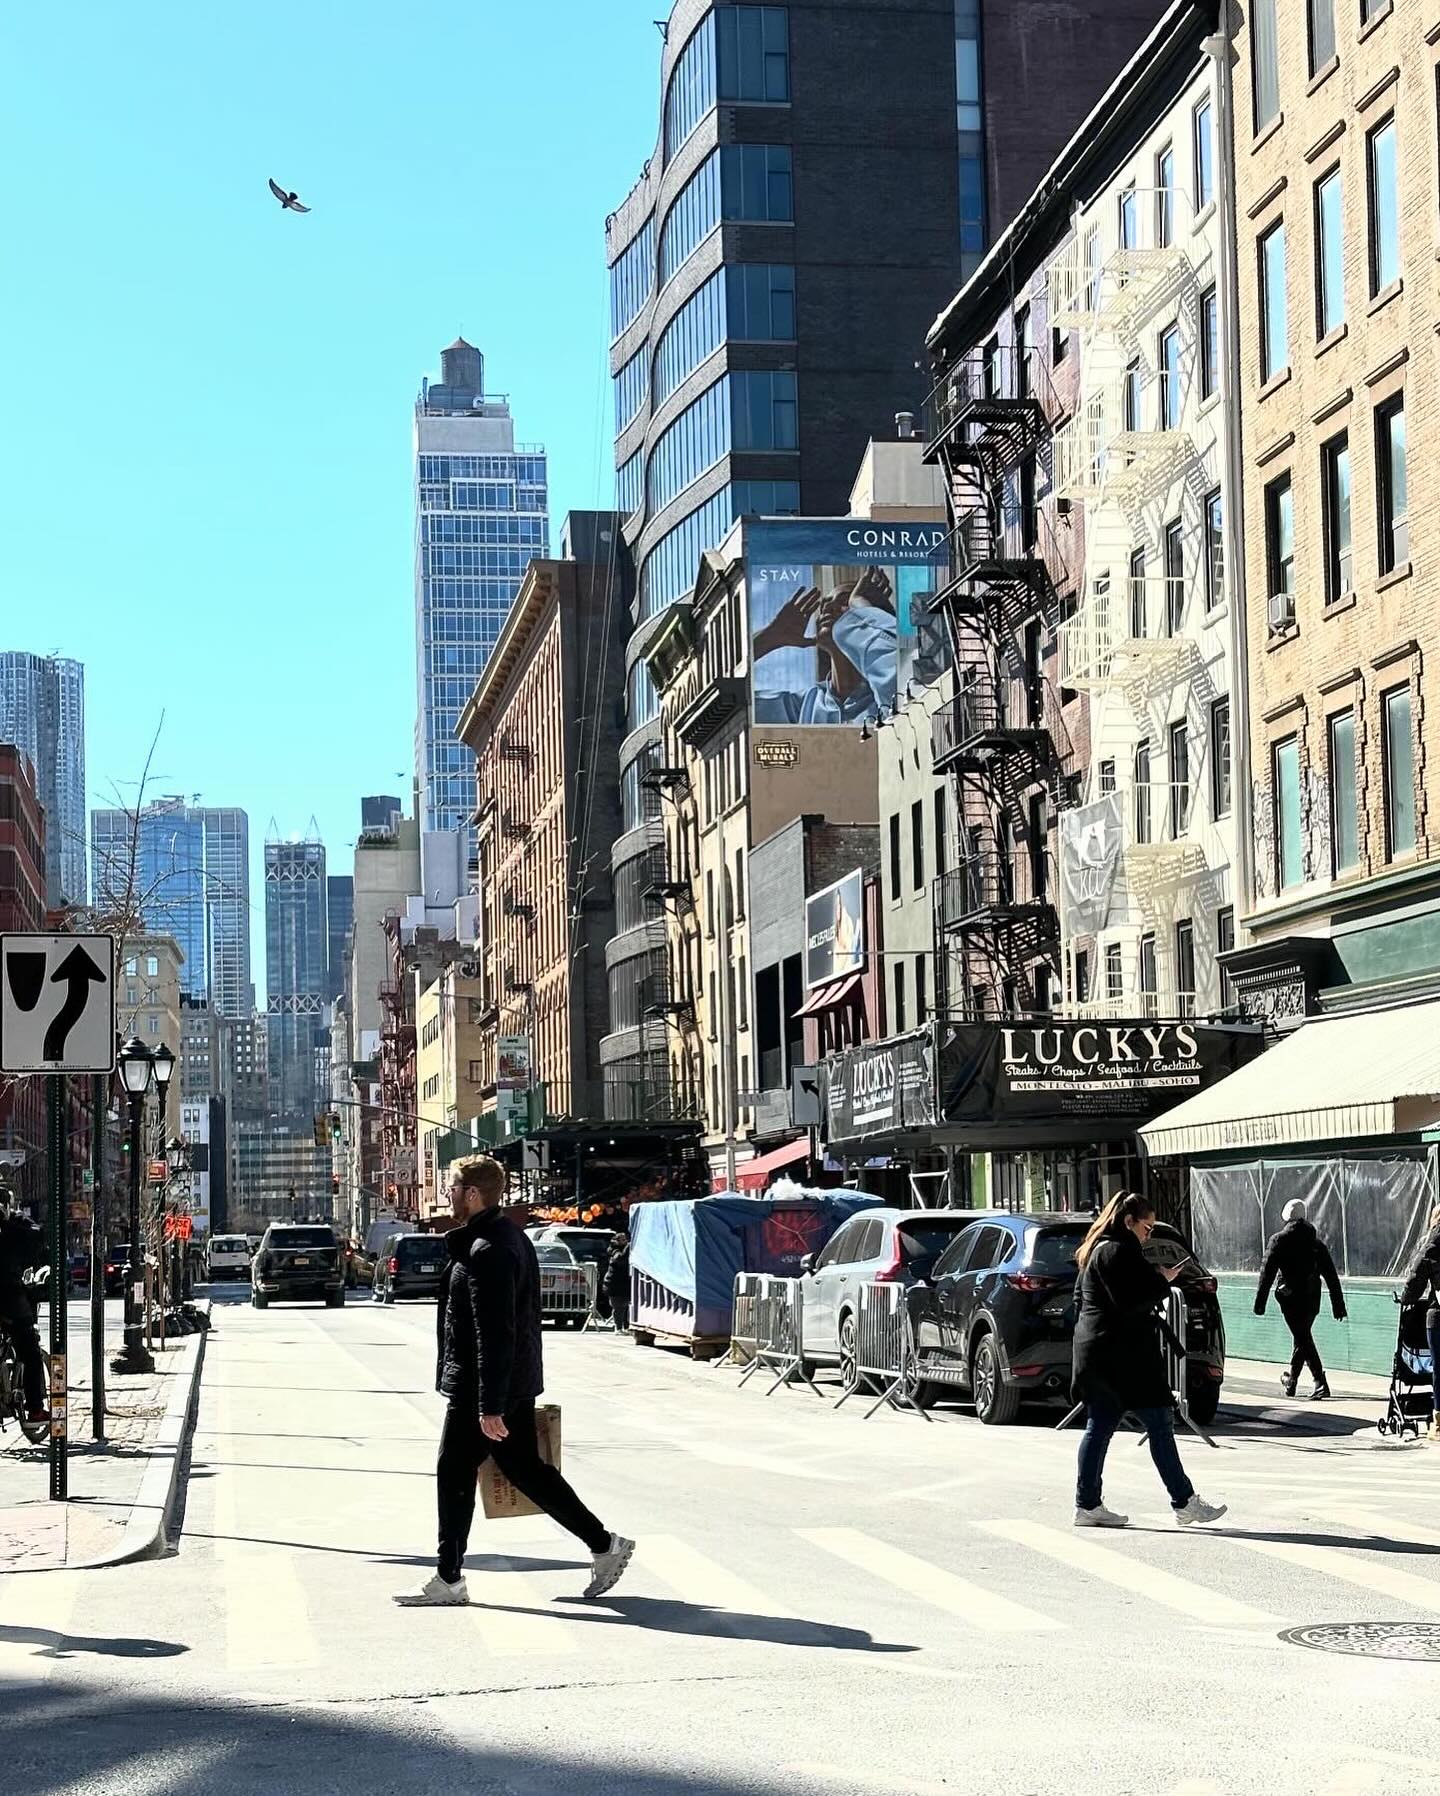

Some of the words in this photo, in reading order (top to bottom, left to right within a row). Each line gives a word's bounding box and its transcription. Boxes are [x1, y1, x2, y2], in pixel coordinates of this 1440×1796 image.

[847, 530, 945, 547] CONRAD
[856, 551, 888, 559] HOTELS
[759, 569, 800, 582] STAY
[1000, 1024, 1198, 1064] LUCKYS
[853, 1051, 895, 1097] LUCKYS
[1004, 1064, 1041, 1077] Steaks
[1051, 1064, 1086, 1081] Chops
[1097, 1062, 1142, 1079] Seafood
[1152, 1058, 1204, 1072] Cocktails
[1016, 1080, 1092, 1090] MONTECITO
[1101, 1077, 1151, 1089] MALIBU
[1159, 1076, 1195, 1086] SOHO
